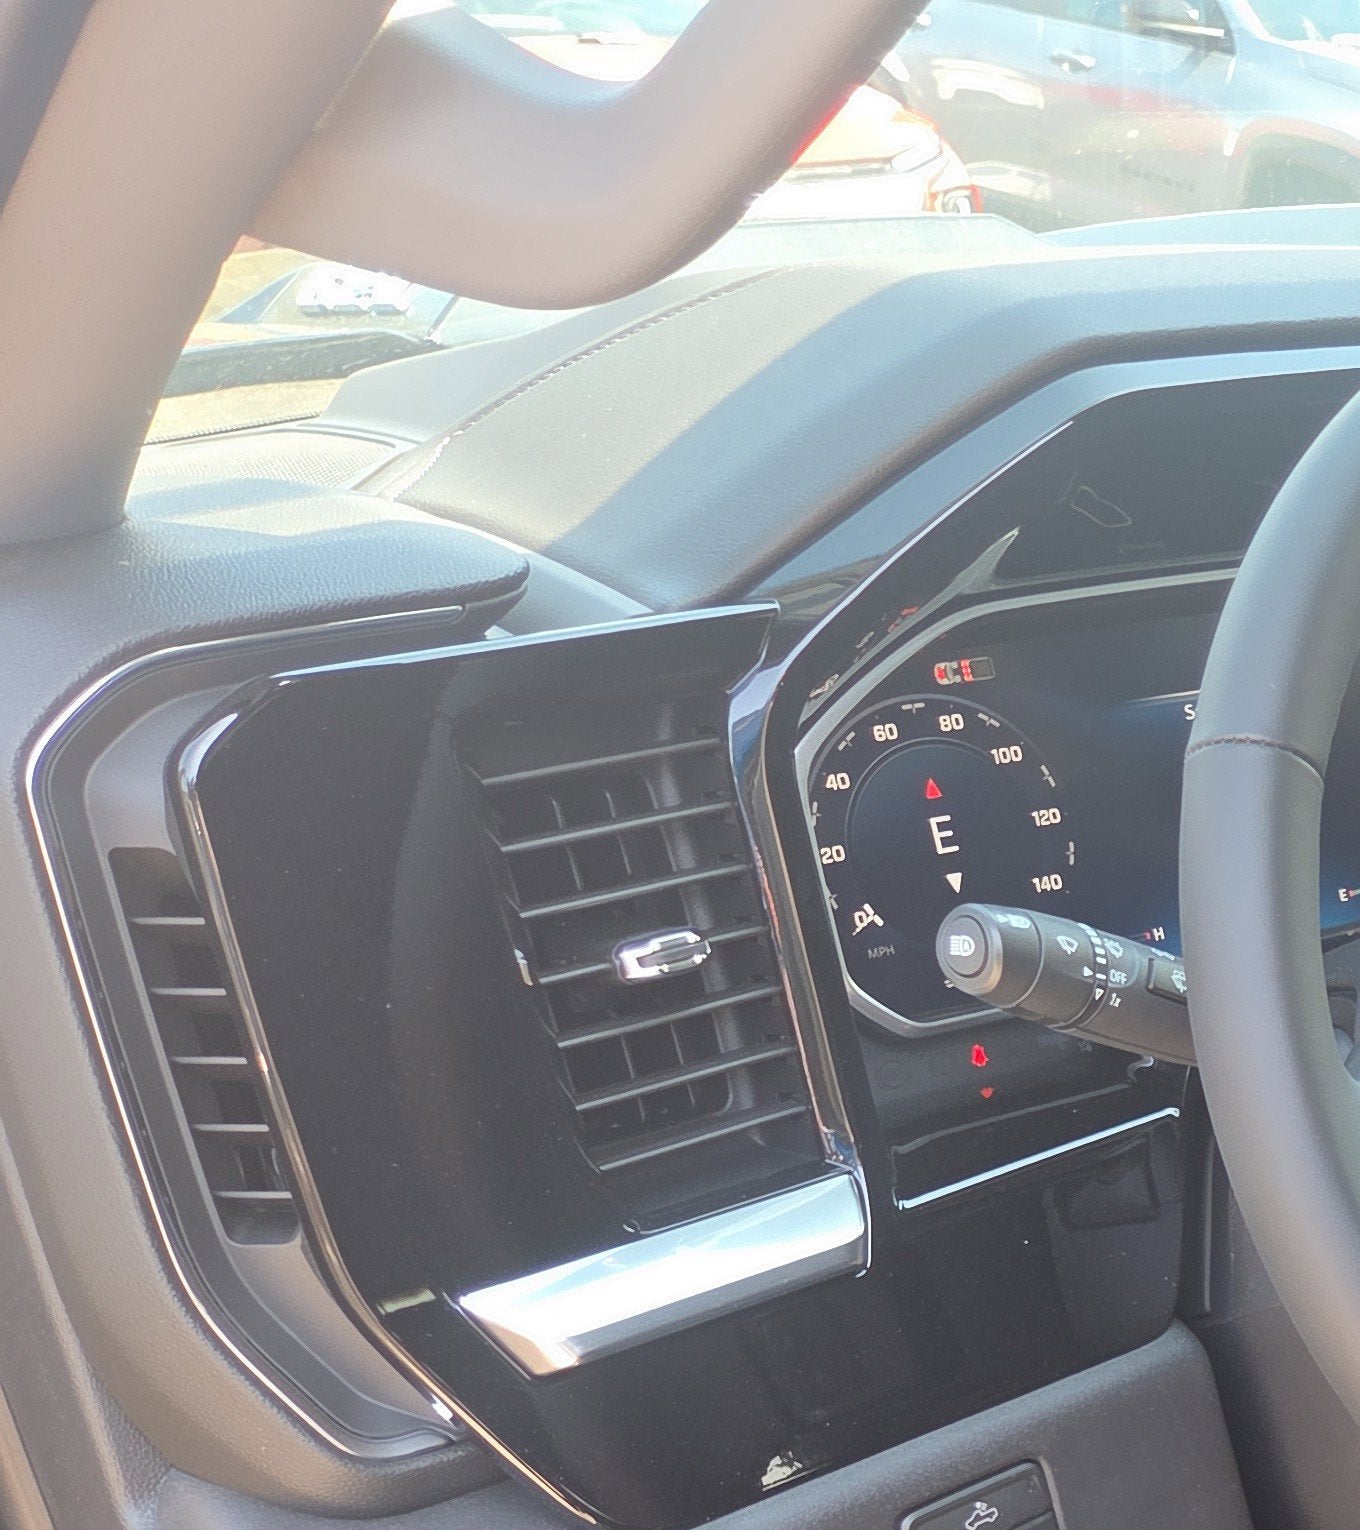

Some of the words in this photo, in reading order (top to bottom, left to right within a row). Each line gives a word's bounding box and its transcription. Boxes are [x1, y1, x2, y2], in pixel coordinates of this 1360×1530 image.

[873, 723, 898, 741] 60
[938, 713, 964, 732] 80
[990, 745, 1023, 765] 100
[825, 772, 851, 791] 40
[1031, 807, 1061, 827] 120
[929, 815, 960, 855] E
[820, 844, 846, 865] 20
[1032, 874, 1063, 893] 140
[1338, 889, 1348, 902] E
[1152, 926, 1165, 941] H
[867, 945, 896, 960] MPH
[1109, 968, 1127, 986] OFF
